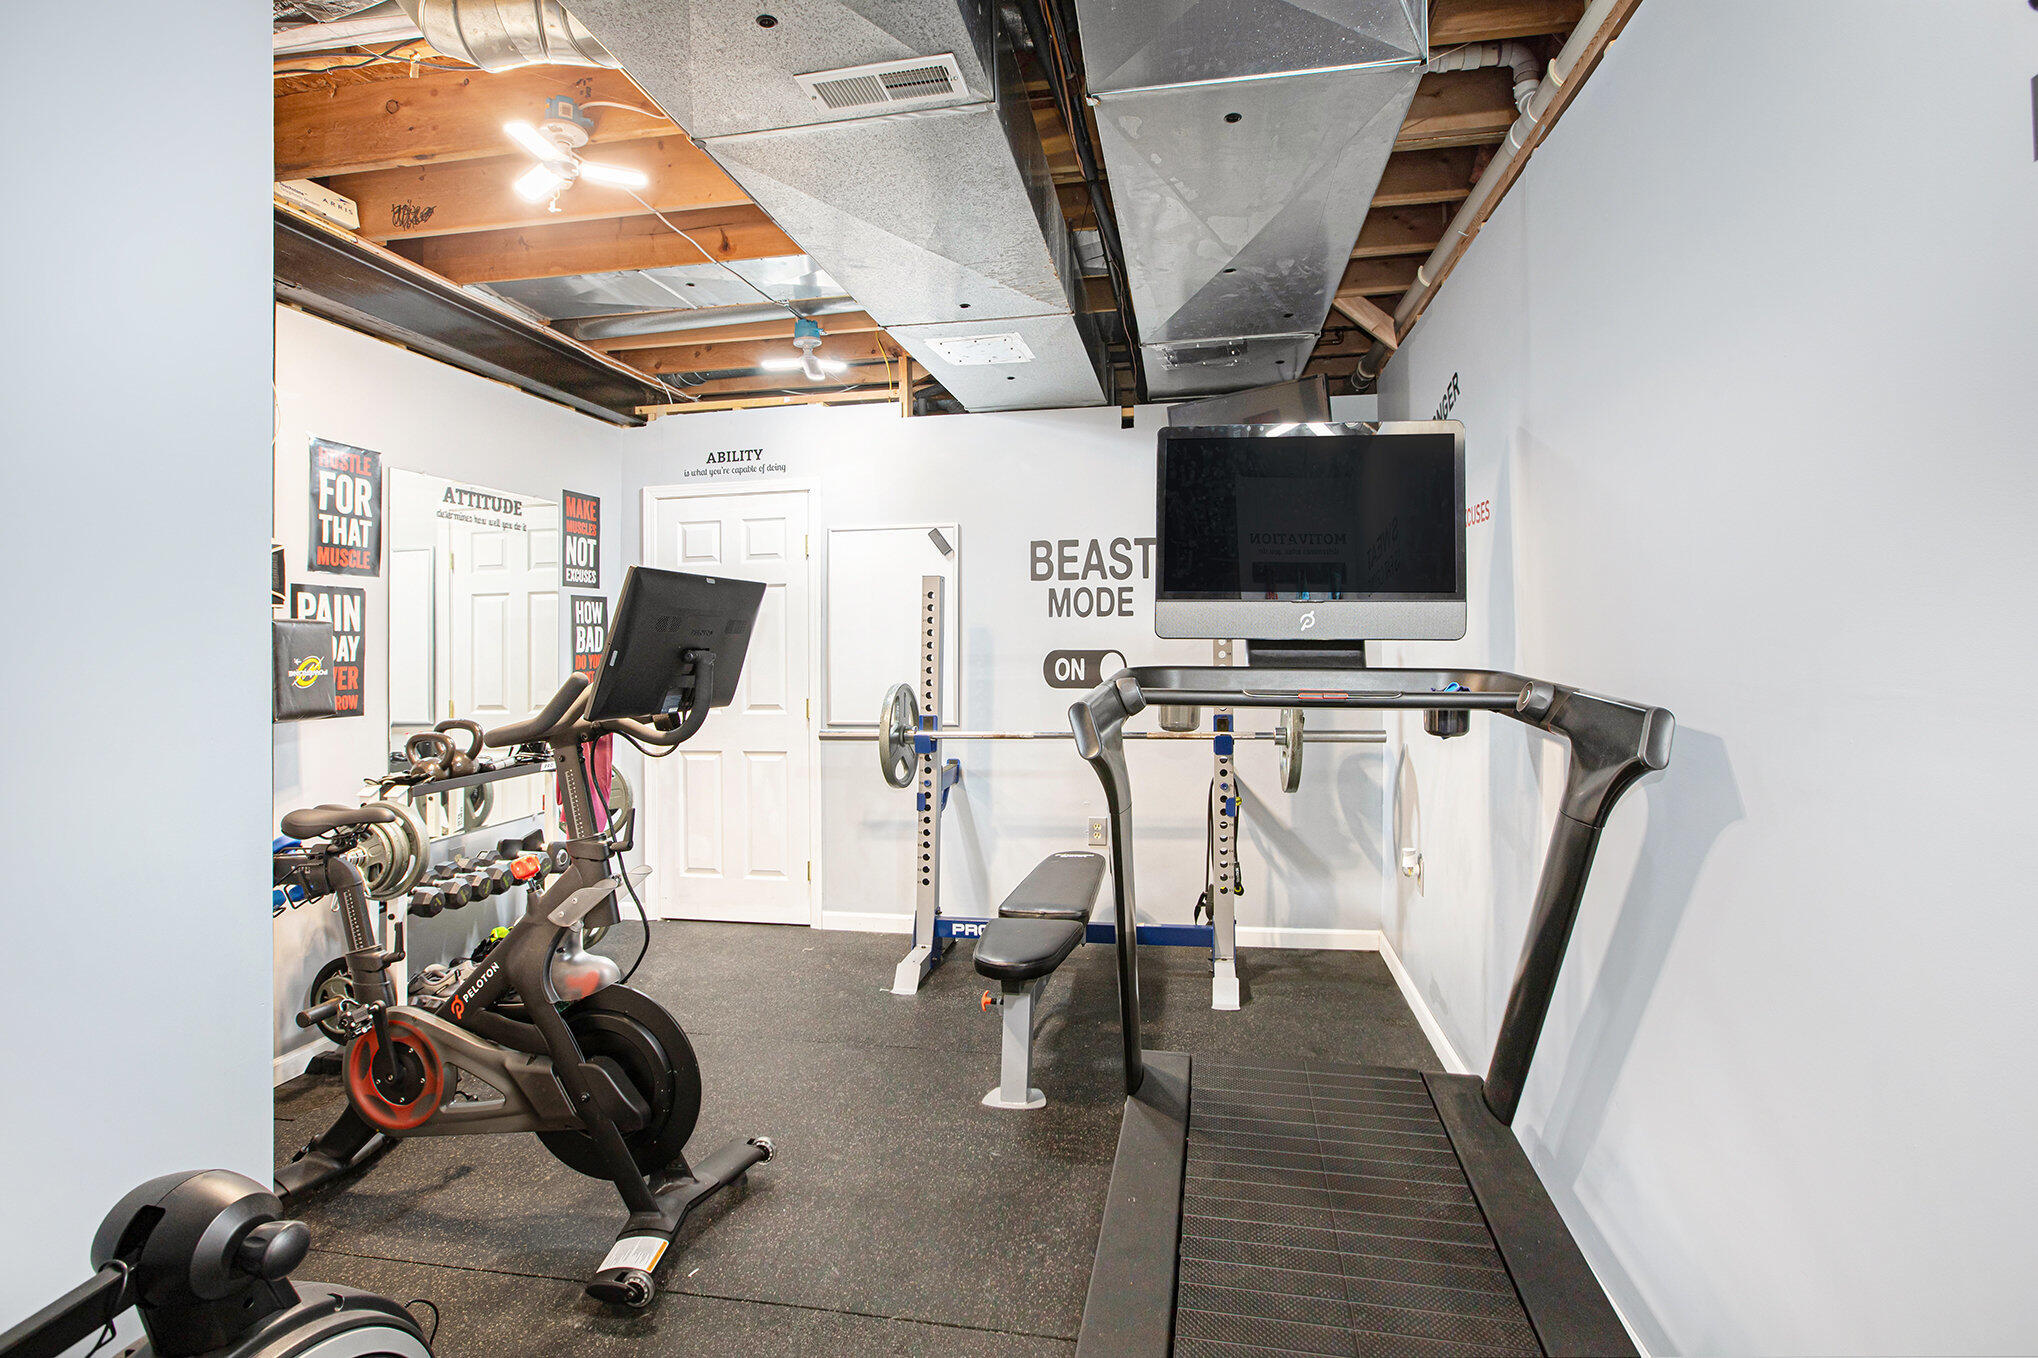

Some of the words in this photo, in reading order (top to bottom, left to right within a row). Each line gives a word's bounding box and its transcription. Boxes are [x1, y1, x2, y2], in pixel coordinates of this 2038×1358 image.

[1433, 372, 1460, 420] NGER
[319, 446, 372, 476] HUSTLE
[684, 469, 690, 477] is
[691, 468, 708, 477] what
[709, 466, 730, 477] you're
[731, 464, 757, 475] capable
[758, 464, 766, 473] of
[766, 463, 787, 473] doing
[706, 448, 763, 464] ABILITY
[319, 469, 372, 518] FOR
[442, 487, 522, 516] ATTITUDE
[566, 496, 597, 522] MAKE
[318, 513, 372, 548] THAT
[566, 519, 597, 537] MUSCLES
[317, 545, 371, 570] MUSCLE
[565, 535, 597, 568] NOT
[1030, 537, 1156, 581] BEAST
[565, 568, 597, 584] EXCUSES
[297, 591, 360, 632] PAIN
[575, 600, 603, 624] HOW
[1048, 587, 1134, 618] MODE
[576, 626, 604, 653] BAD
[575, 653, 587, 670] DO
[1054, 657, 1085, 681] ON
[462, 961, 500, 1003] PELOTON
